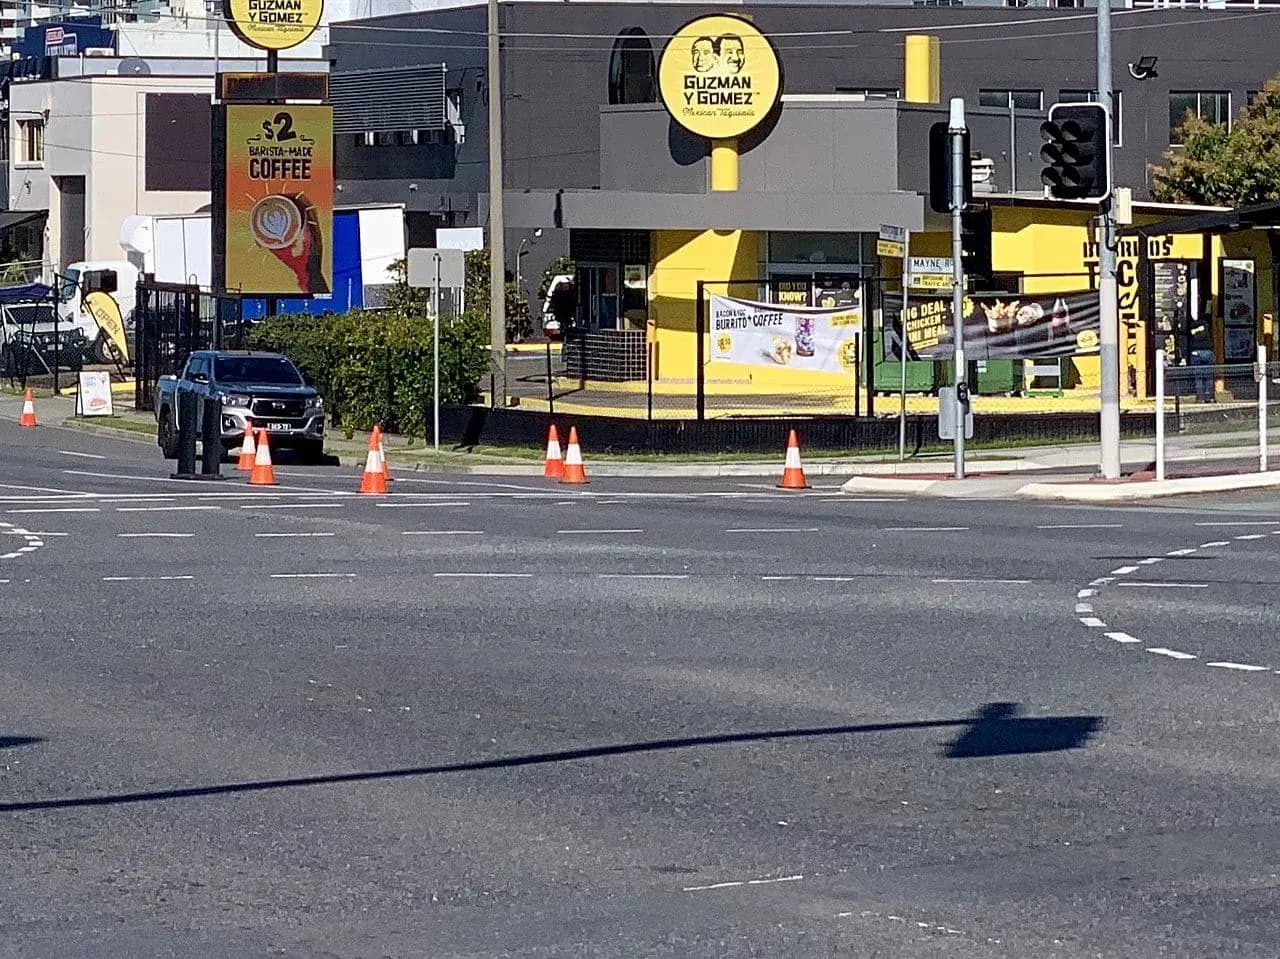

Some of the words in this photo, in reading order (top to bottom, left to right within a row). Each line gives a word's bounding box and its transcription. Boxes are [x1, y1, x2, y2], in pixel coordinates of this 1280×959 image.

[248, 0, 301, 11] GUZMAN
[248, 12, 257, 22] Y
[259, 12, 303, 24] GOMEZ
[683, 74, 751, 89] GUZMAN
[683, 92, 694, 105] Y
[697, 91, 753, 105] GOMEZ
[262, 112, 297, 142] $2
[248, 146, 313, 157] BARISTA-MADE
[249, 159, 312, 180] COFFEE
[913, 259, 940, 268] MAYNE
[778, 291, 808, 302] KNOW?
[920, 300, 946, 317] DEAL
[95, 307, 121, 335] OPEN
[715, 316, 748, 330] BURRITO
[752, 312, 784, 327] COFFEE
[906, 314, 941, 331] CHICKEN
[924, 324, 948, 339] MEAL
